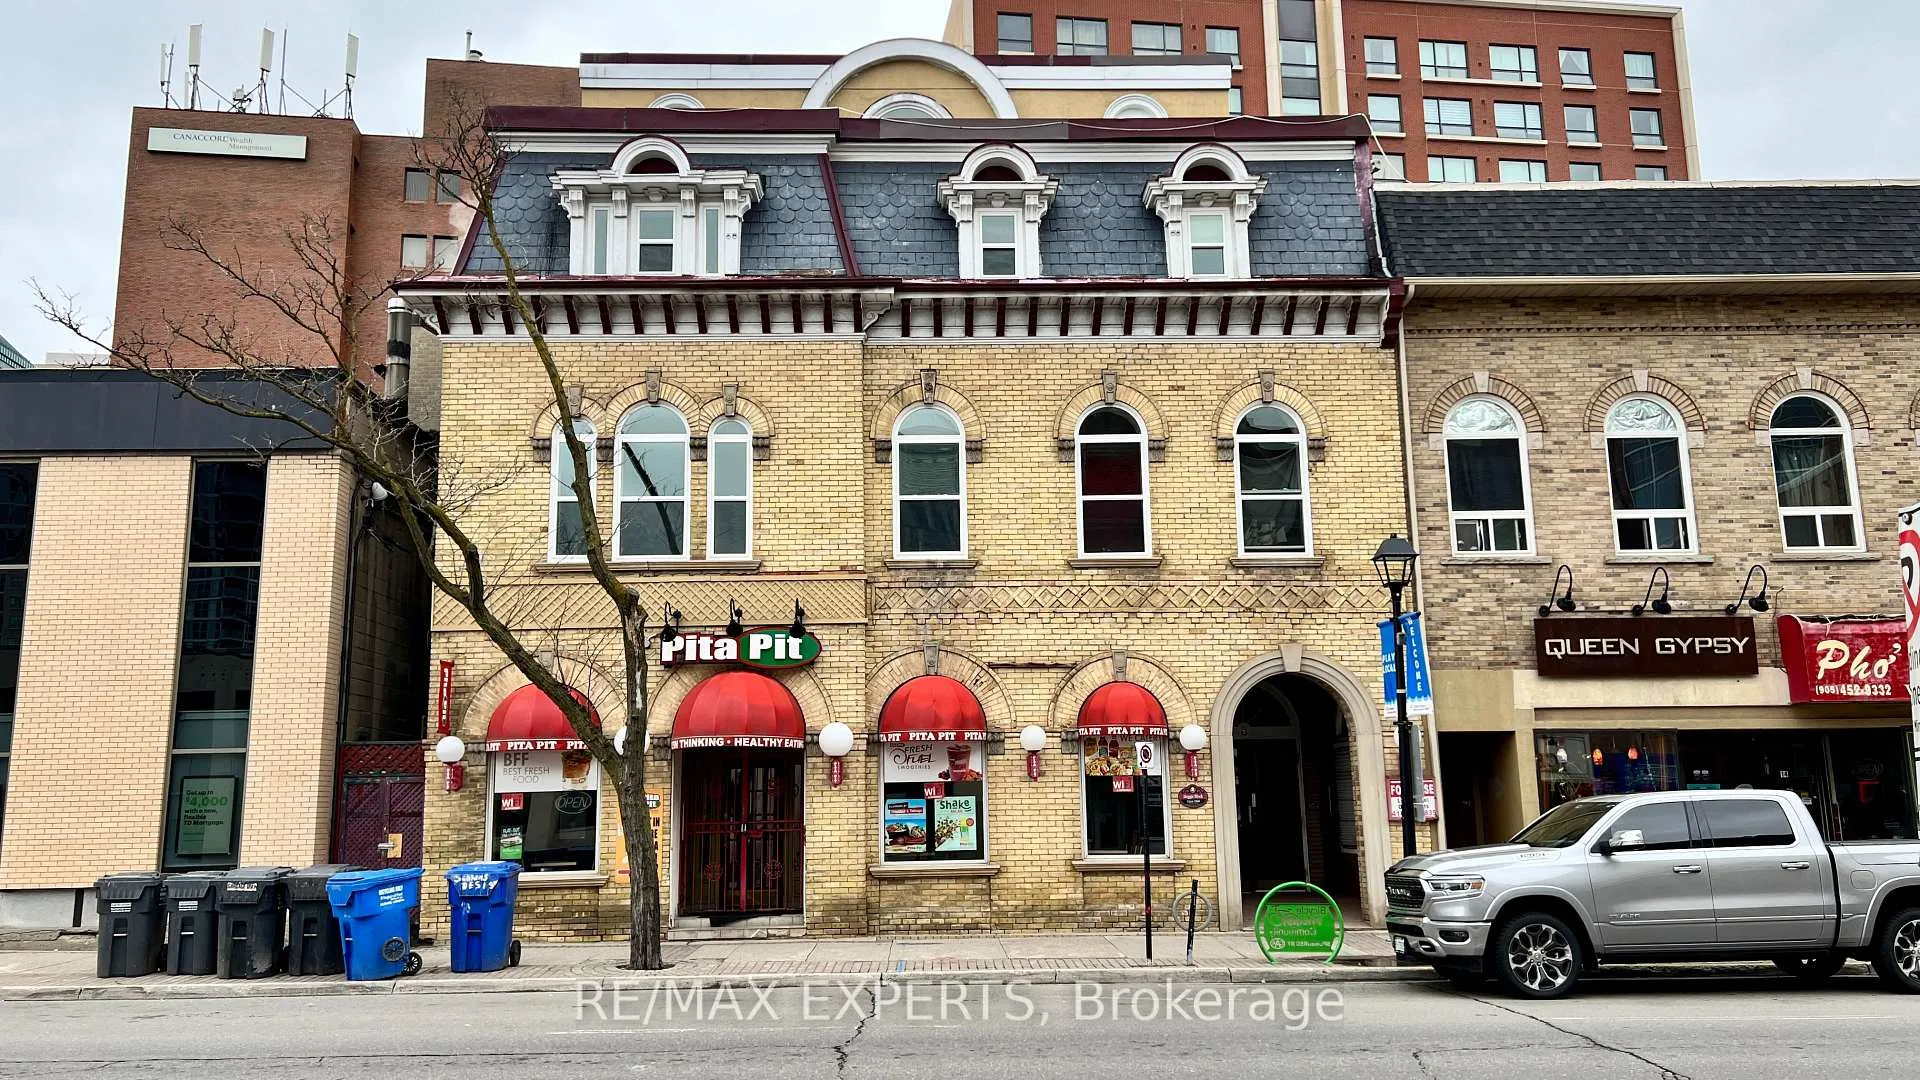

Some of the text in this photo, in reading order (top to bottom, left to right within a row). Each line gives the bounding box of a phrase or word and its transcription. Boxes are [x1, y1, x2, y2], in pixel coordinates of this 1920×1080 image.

[661, 633, 803, 662] Pita Pit
[1545, 636, 1749, 660] QUEEN GYPSY
[1382, 653, 1395, 663] PLAY
[1407, 616, 1423, 692] WELCOME
[909, 732, 935, 741] PITA
[937, 732, 957, 740] PIT
[1107, 727, 1128, 735] PITA
[1130, 727, 1144, 735] PIT
[507, 741, 534, 751] PITA
[536, 740, 557, 750] PIT
[679, 737, 725, 748] THINKING
[734, 737, 784, 748] HEALTHY
[904, 743, 932, 754] FRESH
[503, 752, 529, 767] BFF
[503, 767, 550, 776] BEST FRESH
[513, 775, 539, 784] FOOD
[557, 796, 589, 808] OPEN
[940, 799, 972, 810] Shake
